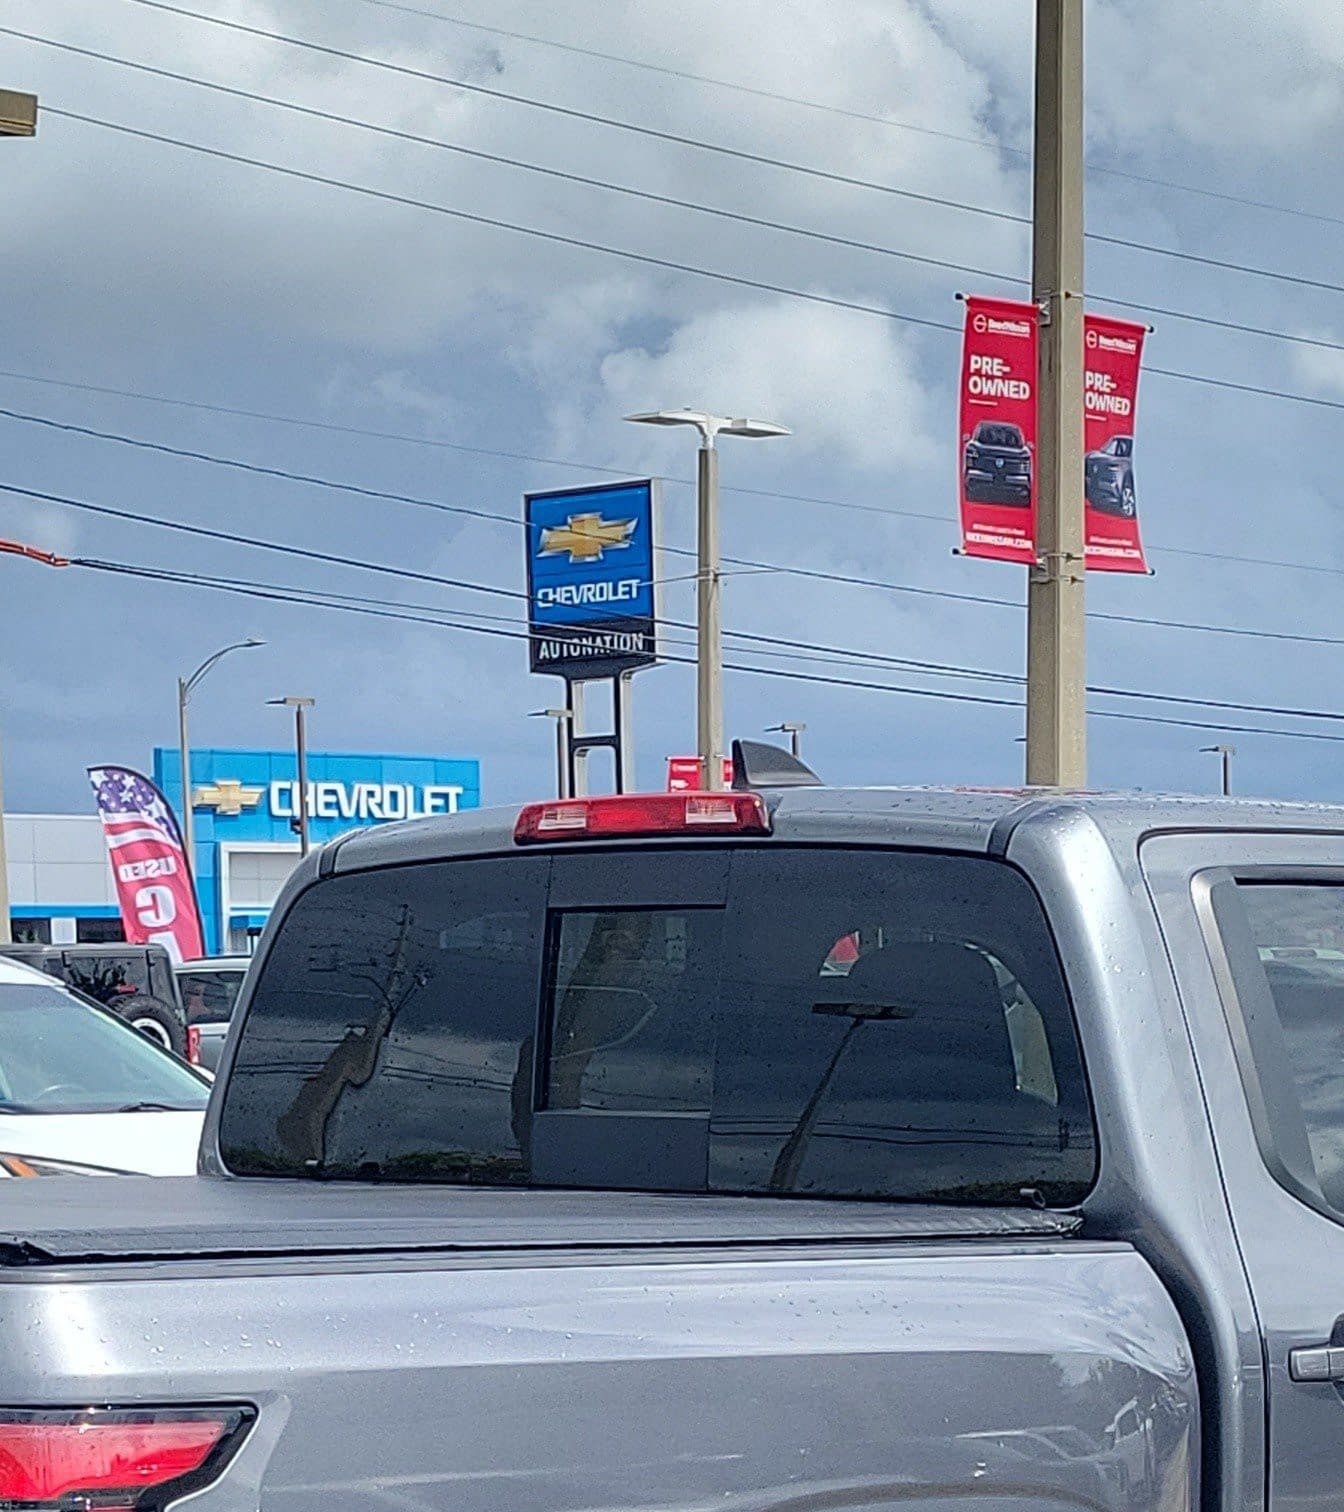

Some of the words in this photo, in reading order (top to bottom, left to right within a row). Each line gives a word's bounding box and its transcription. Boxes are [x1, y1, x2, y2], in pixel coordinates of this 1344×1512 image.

[969, 354, 1011, 376] PRE-
[968, 376, 1030, 400] OWNED
[1086, 371, 1117, 392] PRE-
[1085, 391, 1131, 416] OWNED
[537, 579, 641, 608] CHEVROLET
[539, 632, 645, 660] AUTONATION
[270, 781, 464, 820] CHEVROLET
